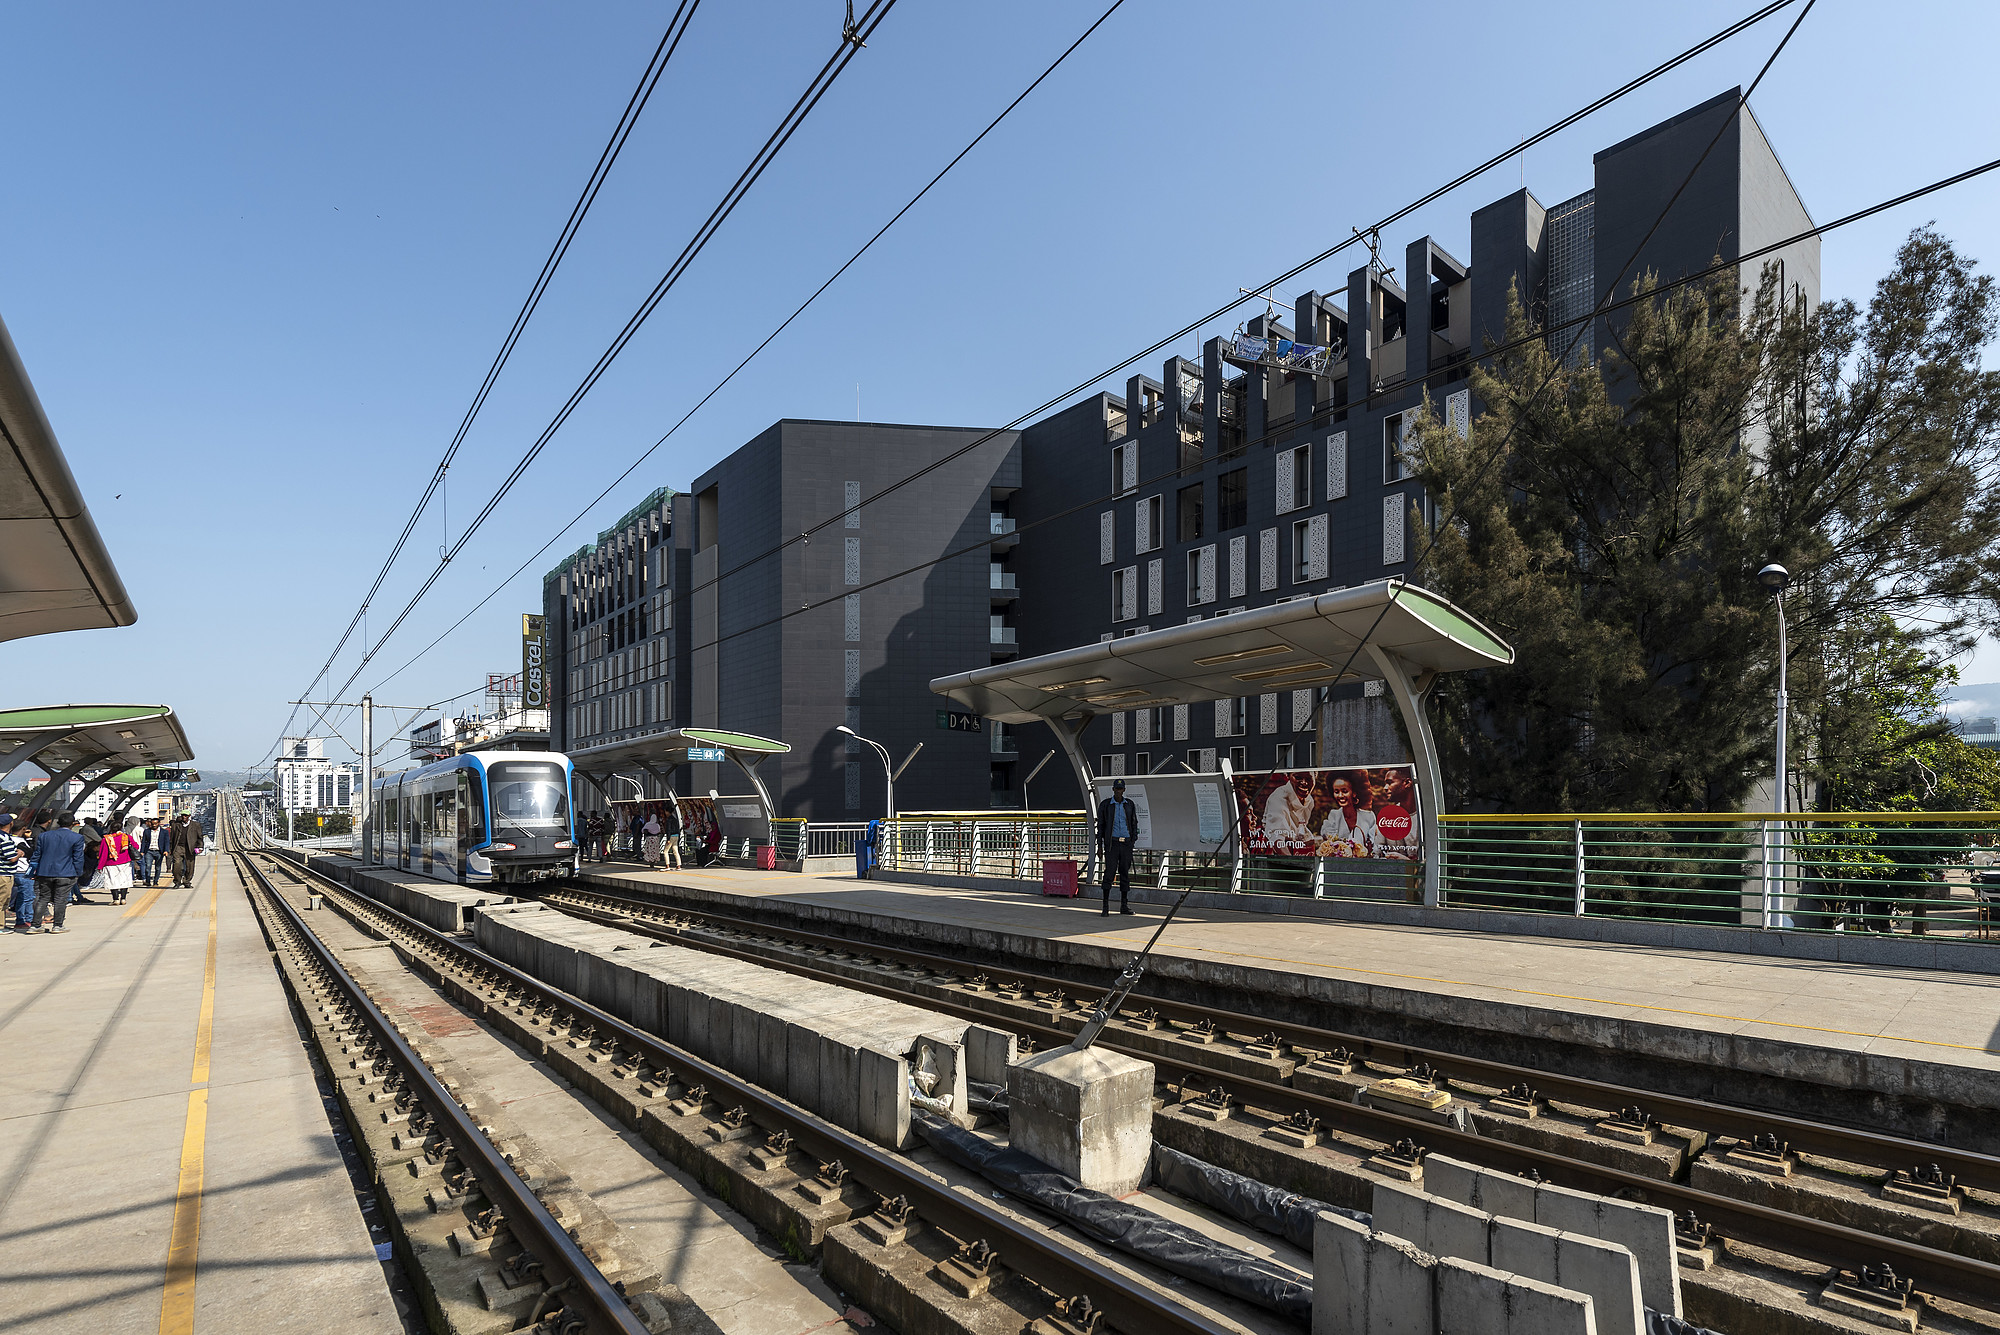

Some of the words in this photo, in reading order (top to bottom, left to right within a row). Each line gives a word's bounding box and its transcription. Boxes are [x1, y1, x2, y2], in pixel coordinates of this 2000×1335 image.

[950, 714, 957, 728] D
[155, 771, 161, 779] A
[1379, 816, 1410, 828] Coca-Cola
